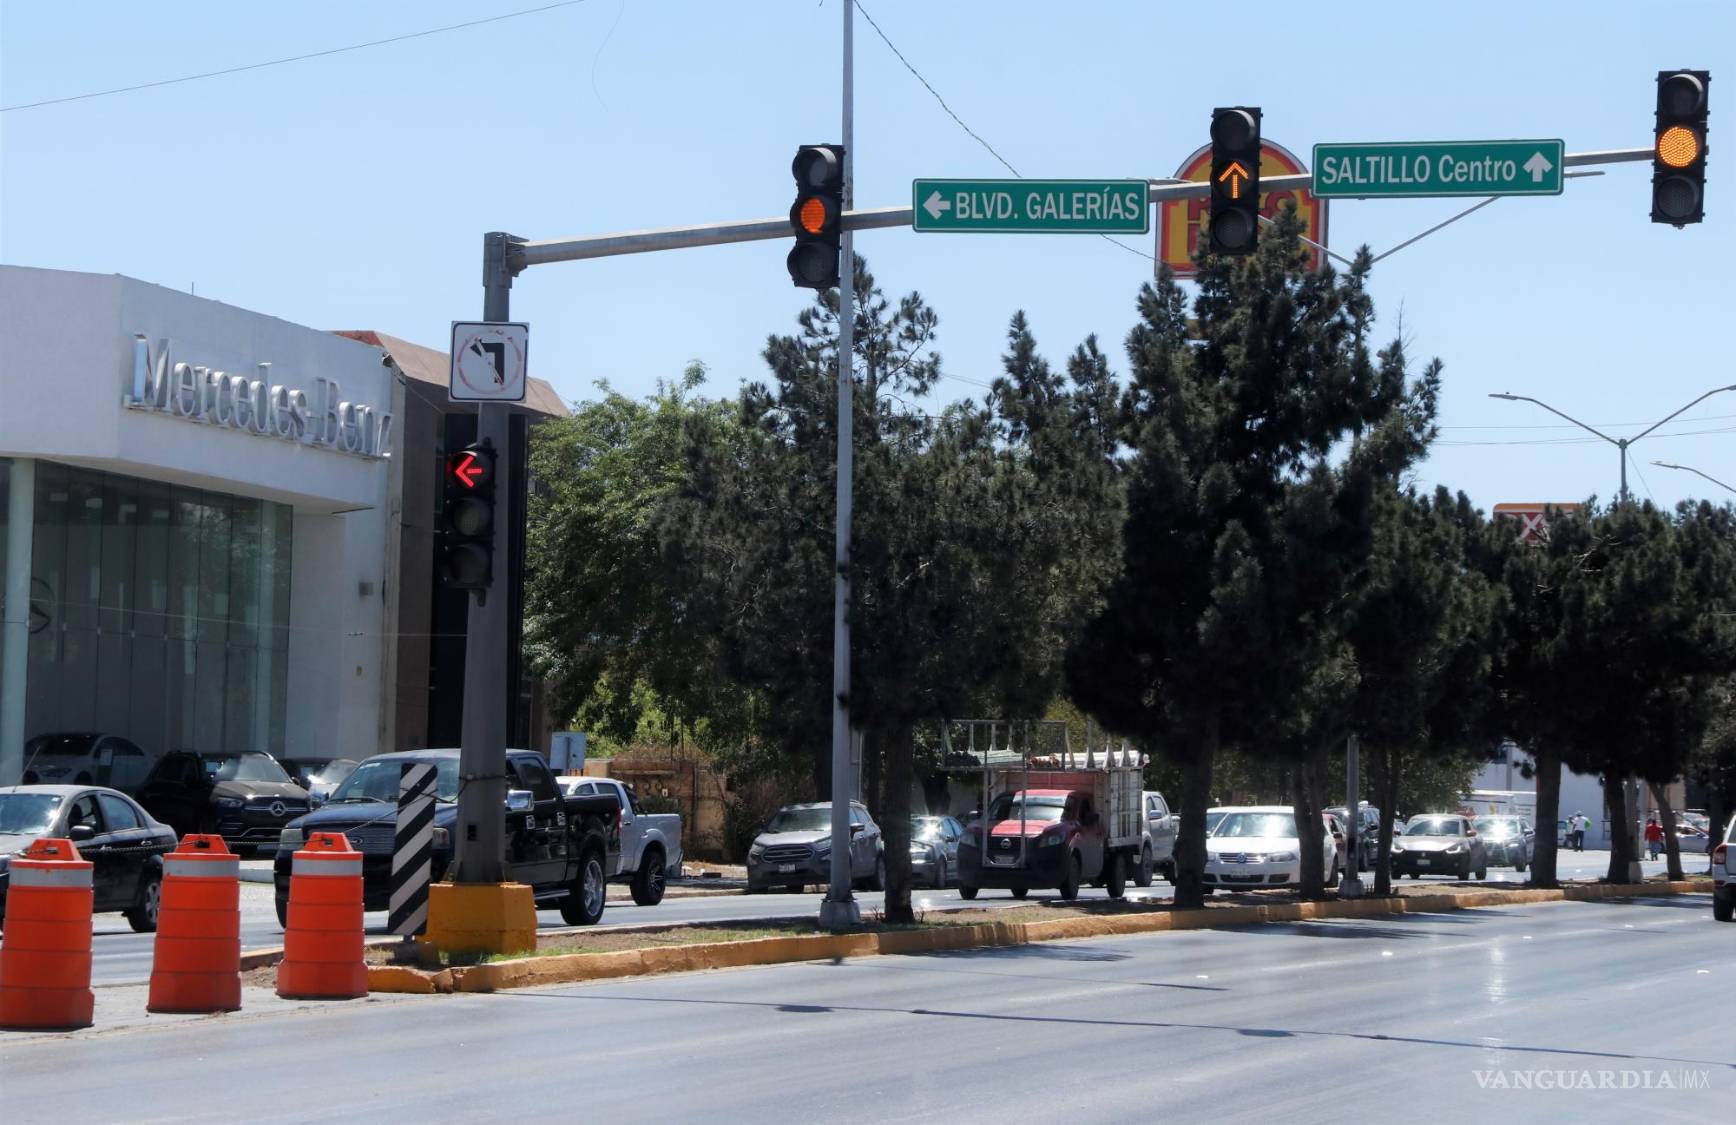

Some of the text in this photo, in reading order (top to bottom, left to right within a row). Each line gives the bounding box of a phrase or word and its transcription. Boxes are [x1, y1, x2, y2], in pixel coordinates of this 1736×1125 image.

[1322, 153, 1517, 185] SALTILLO Centro
[956, 187, 1139, 220] BLVD. GALERÍAS
